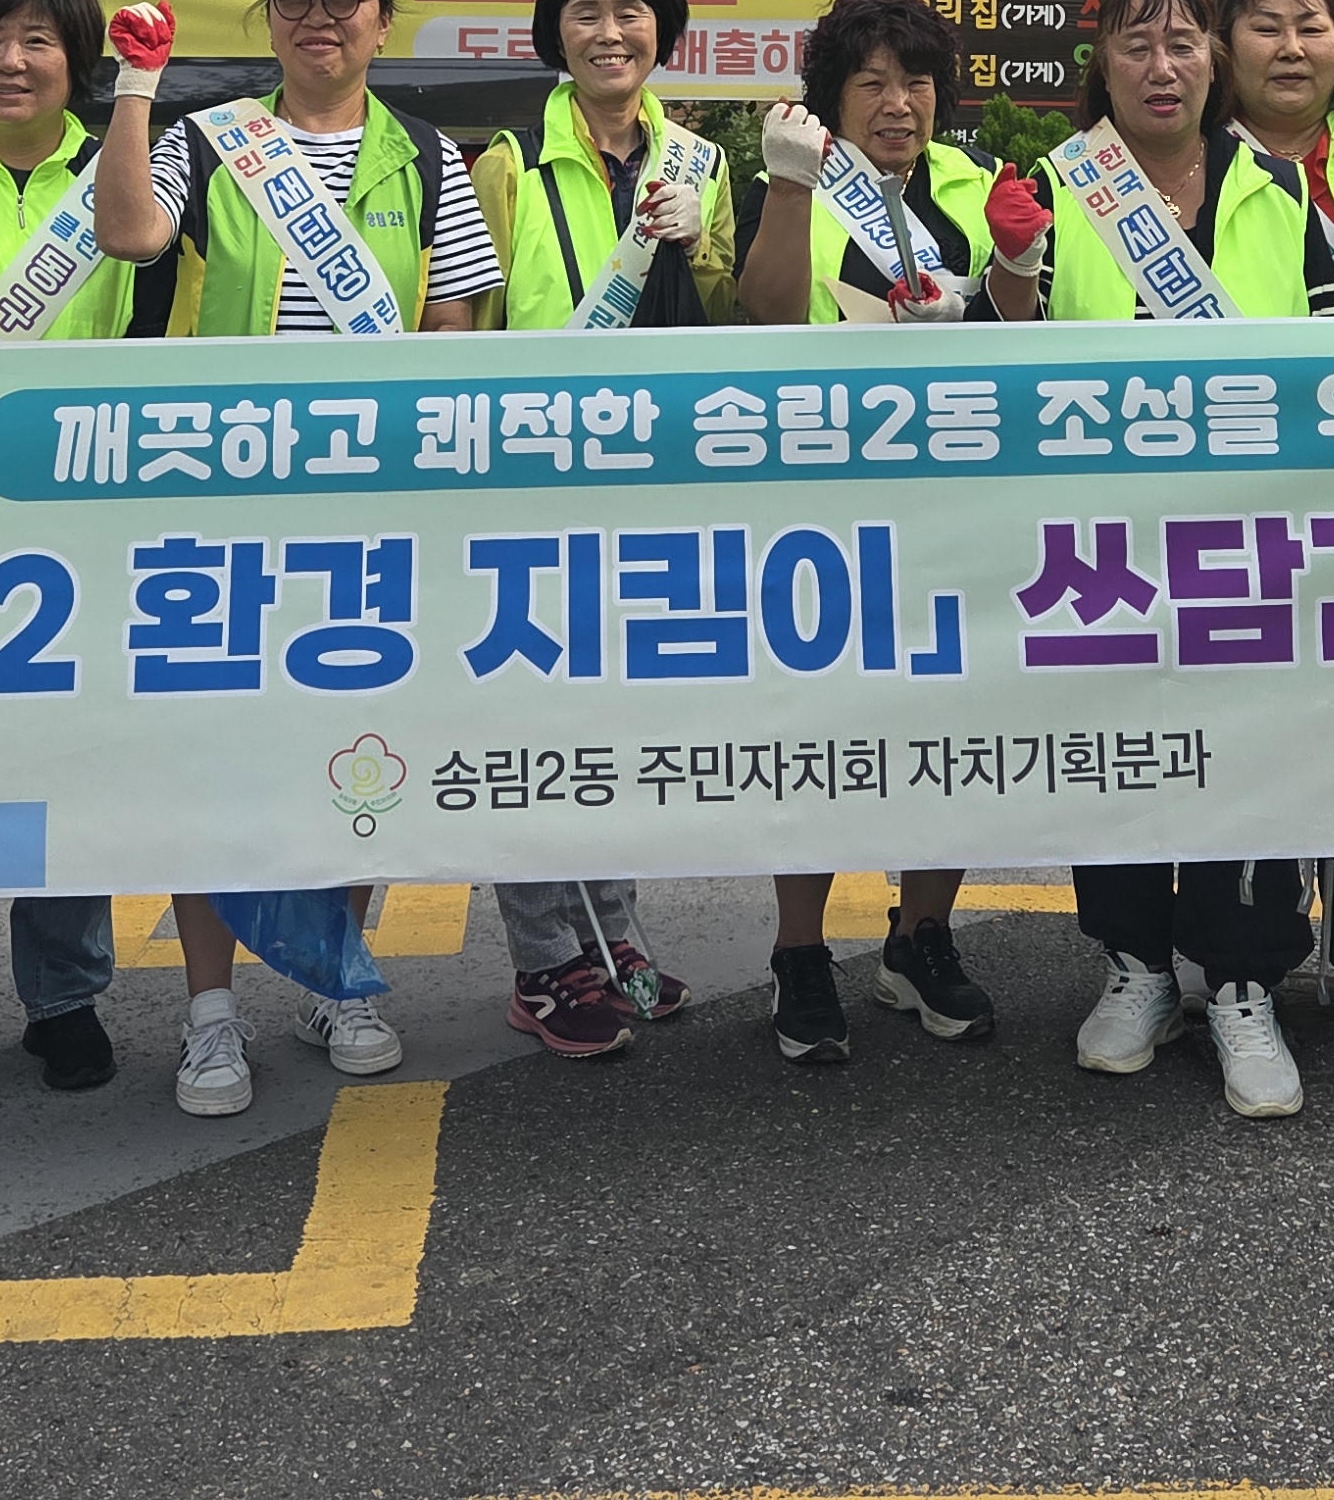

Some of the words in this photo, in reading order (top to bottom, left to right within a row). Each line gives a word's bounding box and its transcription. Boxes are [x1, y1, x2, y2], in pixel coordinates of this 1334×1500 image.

[968, 54, 1065, 87] 집(가게)
[216, 115, 293, 179] 대한민국
[1068, 142, 1146, 218] 대한민국
[263, 166, 371, 302] 새단장
[53, 398, 380, 485] 깨끗하고
[414, 388, 661, 474] 쾌적한
[693, 380, 1001, 467] 송림2동
[1037, 374, 1280, 457] 조성을
[127, 535, 416, 695] 환경
[431, 746, 618, 810] 송림2동
[636, 738, 888, 807] 주민자치회
[908, 729, 1212, 797] 자치기획분과
